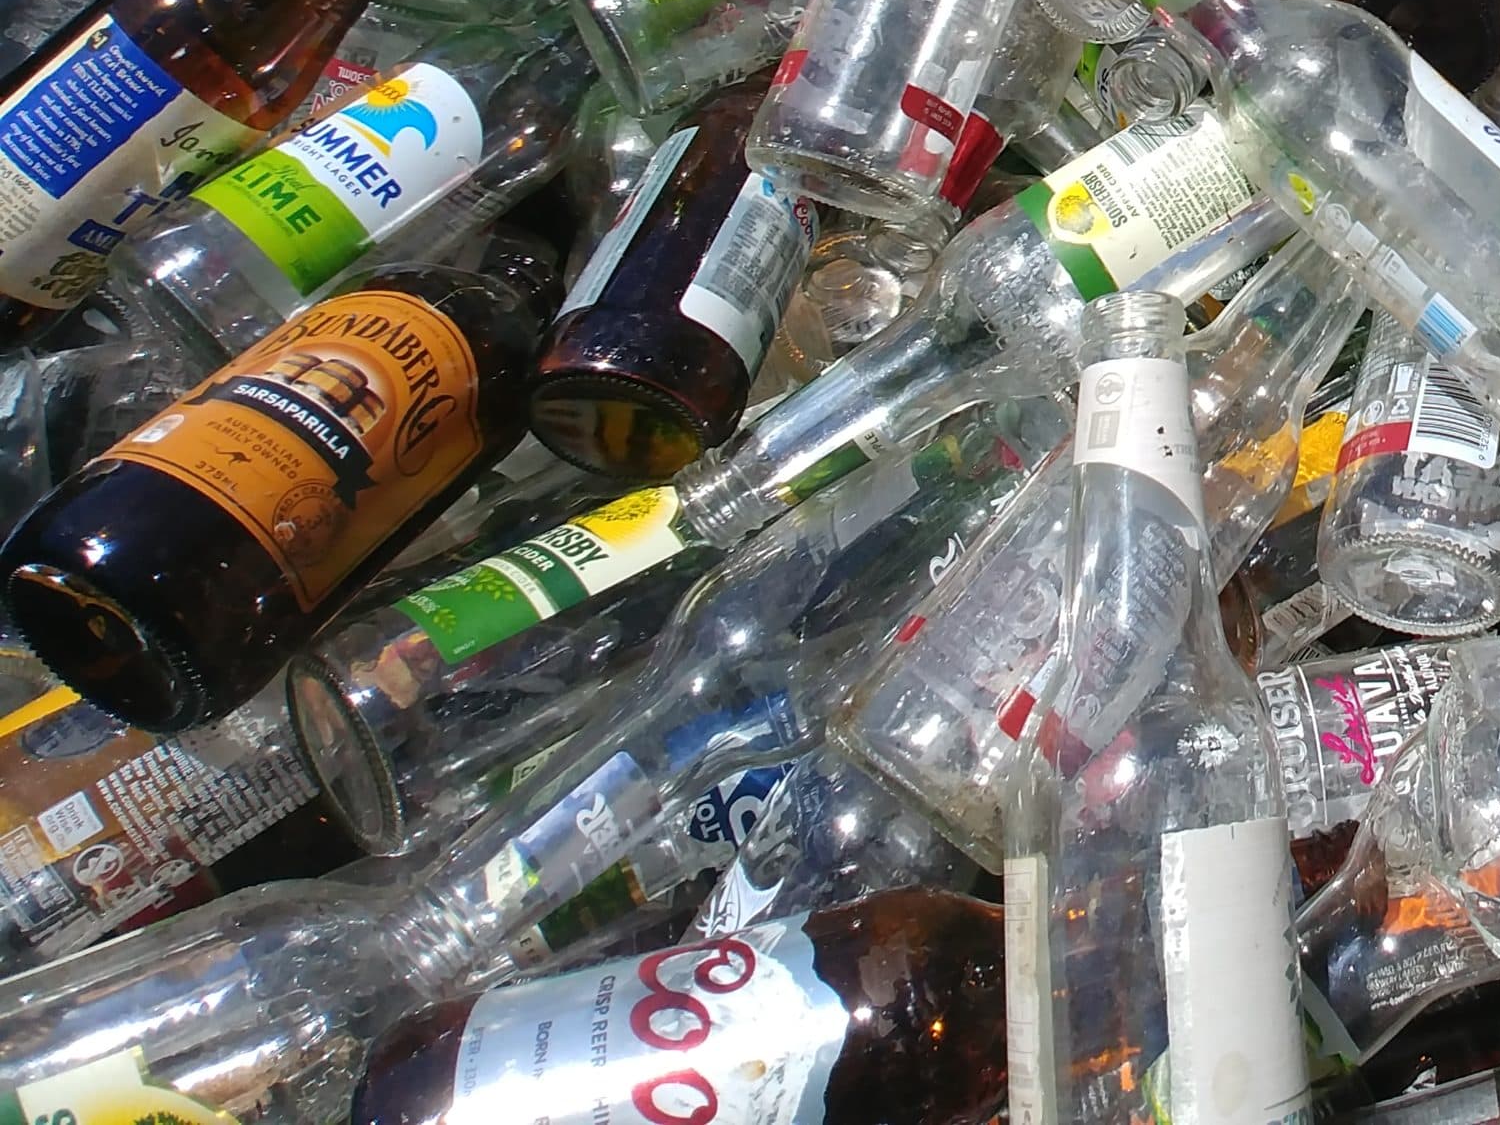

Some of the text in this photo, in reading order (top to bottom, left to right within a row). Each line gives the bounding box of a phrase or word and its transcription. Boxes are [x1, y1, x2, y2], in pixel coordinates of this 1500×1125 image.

[291, 118, 403, 209] SUMMER
[324, 160, 362, 197] LAGER
[232, 165, 322, 234] LIME
[1080, 170, 1128, 228] SOMERSBY
[231, 382, 351, 461] SARSAPARILLA
[257, 311, 457, 477] BUNDABERG
[207, 420, 299, 481] FAMILY OWNED
[223, 416, 304, 469] AUSTRALIAN
[513, 546, 556, 573] CIDER
[591, 974, 617, 1019] CRISP
[534, 1019, 553, 1065] BORN
